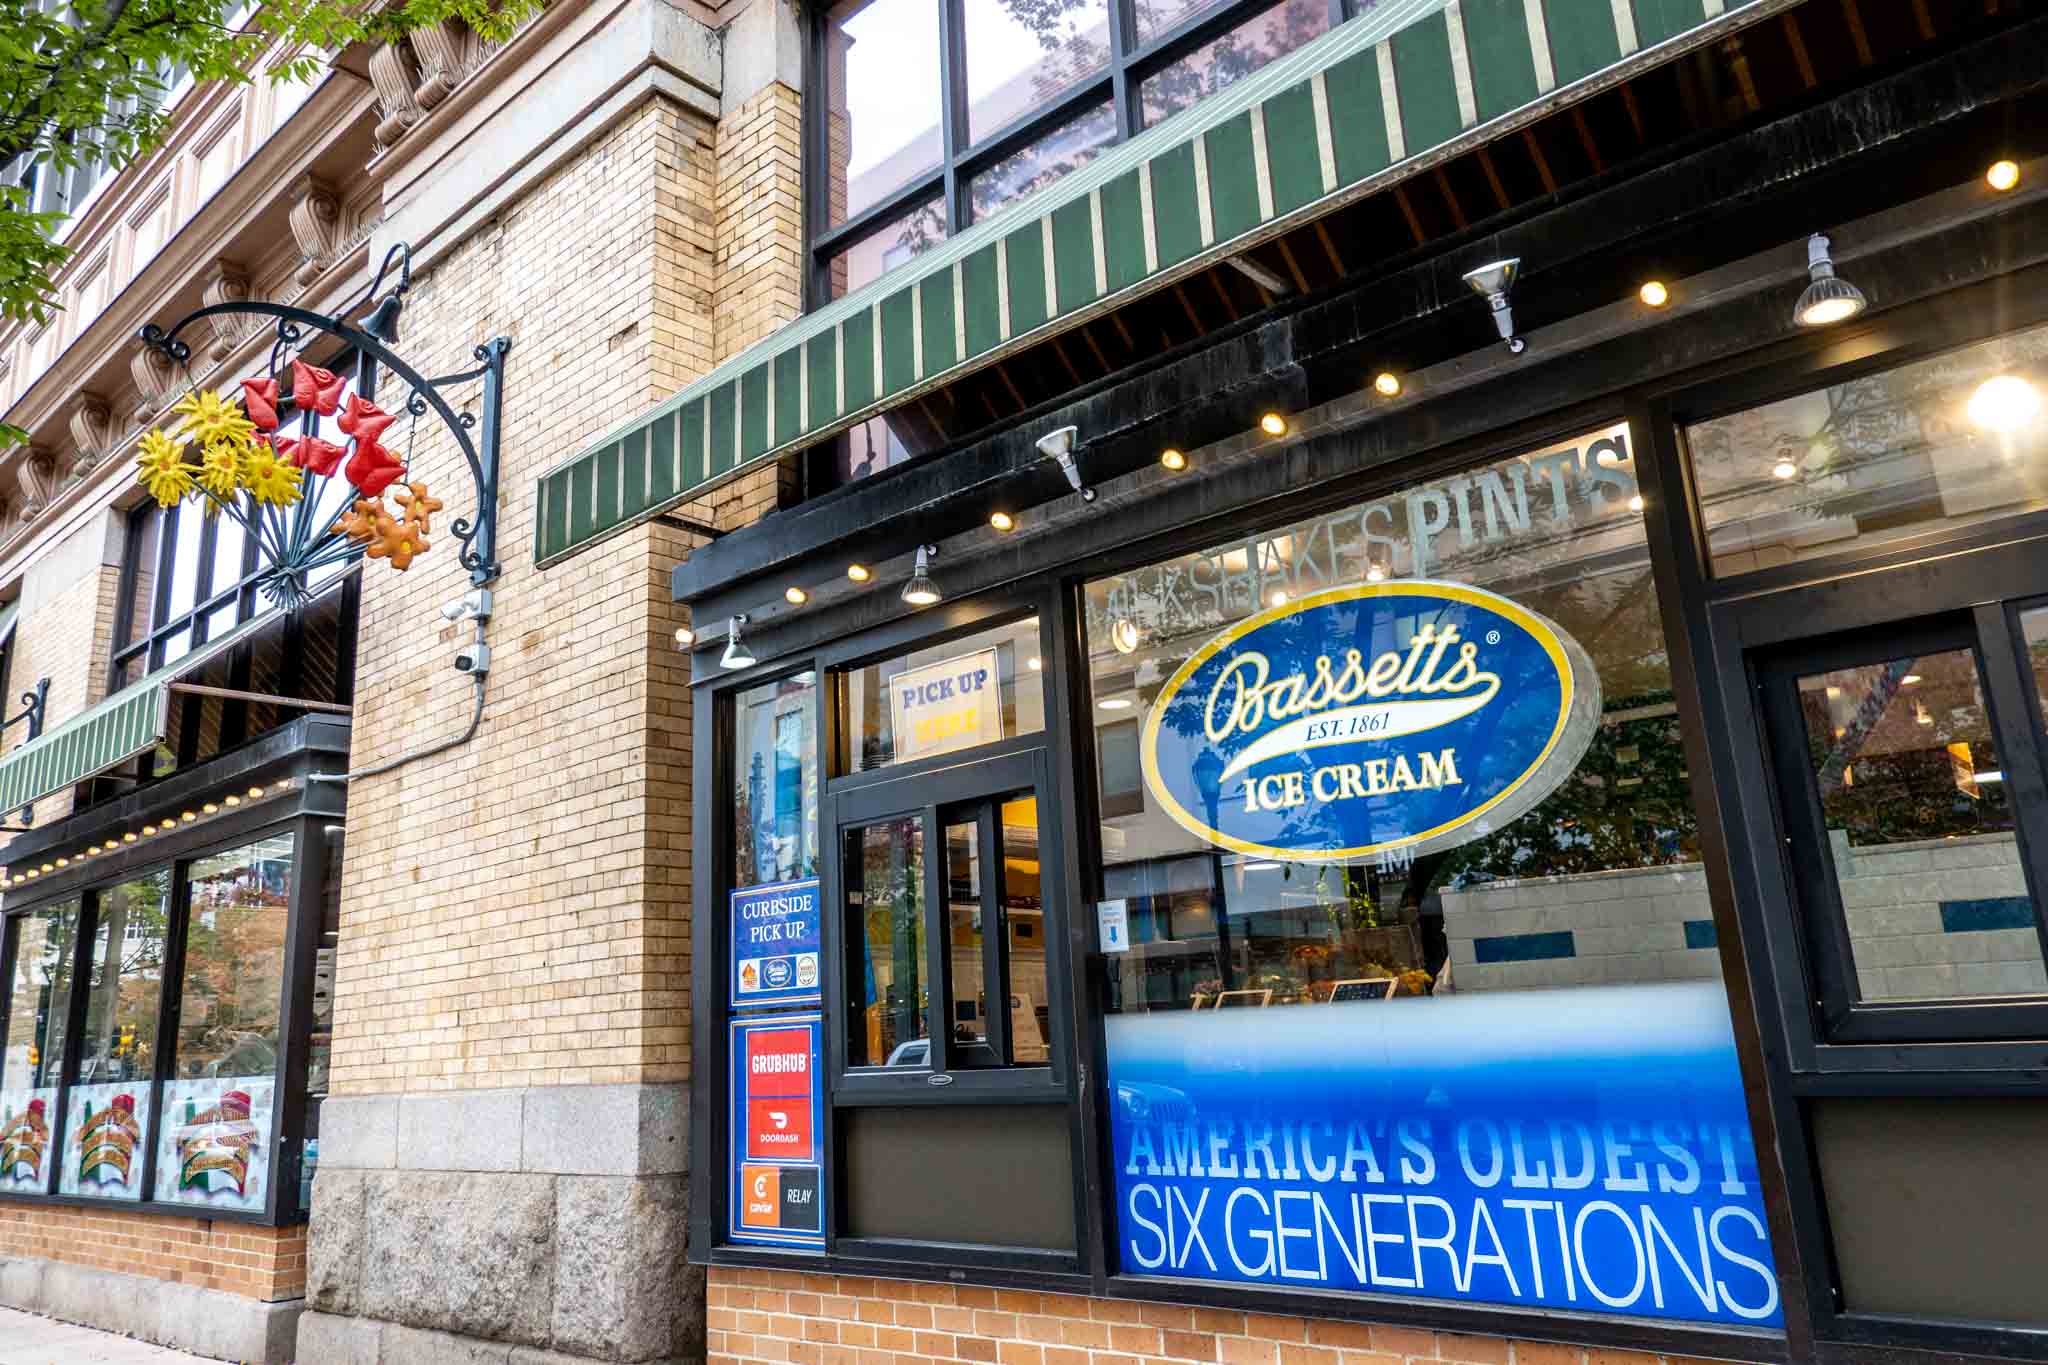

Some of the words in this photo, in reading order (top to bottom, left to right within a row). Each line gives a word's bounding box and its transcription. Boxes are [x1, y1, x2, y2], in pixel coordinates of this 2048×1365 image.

[1405, 434, 1640, 578] PINTS
[902, 677, 956, 710] PICK
[958, 668, 988, 694] UP
[1203, 623, 1501, 744] Bassetts
[1305, 723, 1343, 742] EST.
[1350, 711, 1391, 735] 1861
[1243, 771, 1306, 812] ICE
[1312, 748, 1463, 802] CREAM
[743, 894, 813, 920] CURBSIDE
[750, 923, 782, 943] PICK
[786, 920, 805, 938] UP
[752, 1053, 807, 1073] GRUBHUB
[760, 1133, 800, 1144] DOORDASH
[1124, 1115, 1437, 1185] AMERICA'S
[1457, 1117, 1758, 1196] OLDEST
[787, 1188, 812, 1203] RELAY
[1129, 1183, 1218, 1272] SIX
[1224, 1186, 1779, 1319] GENERATIONS
